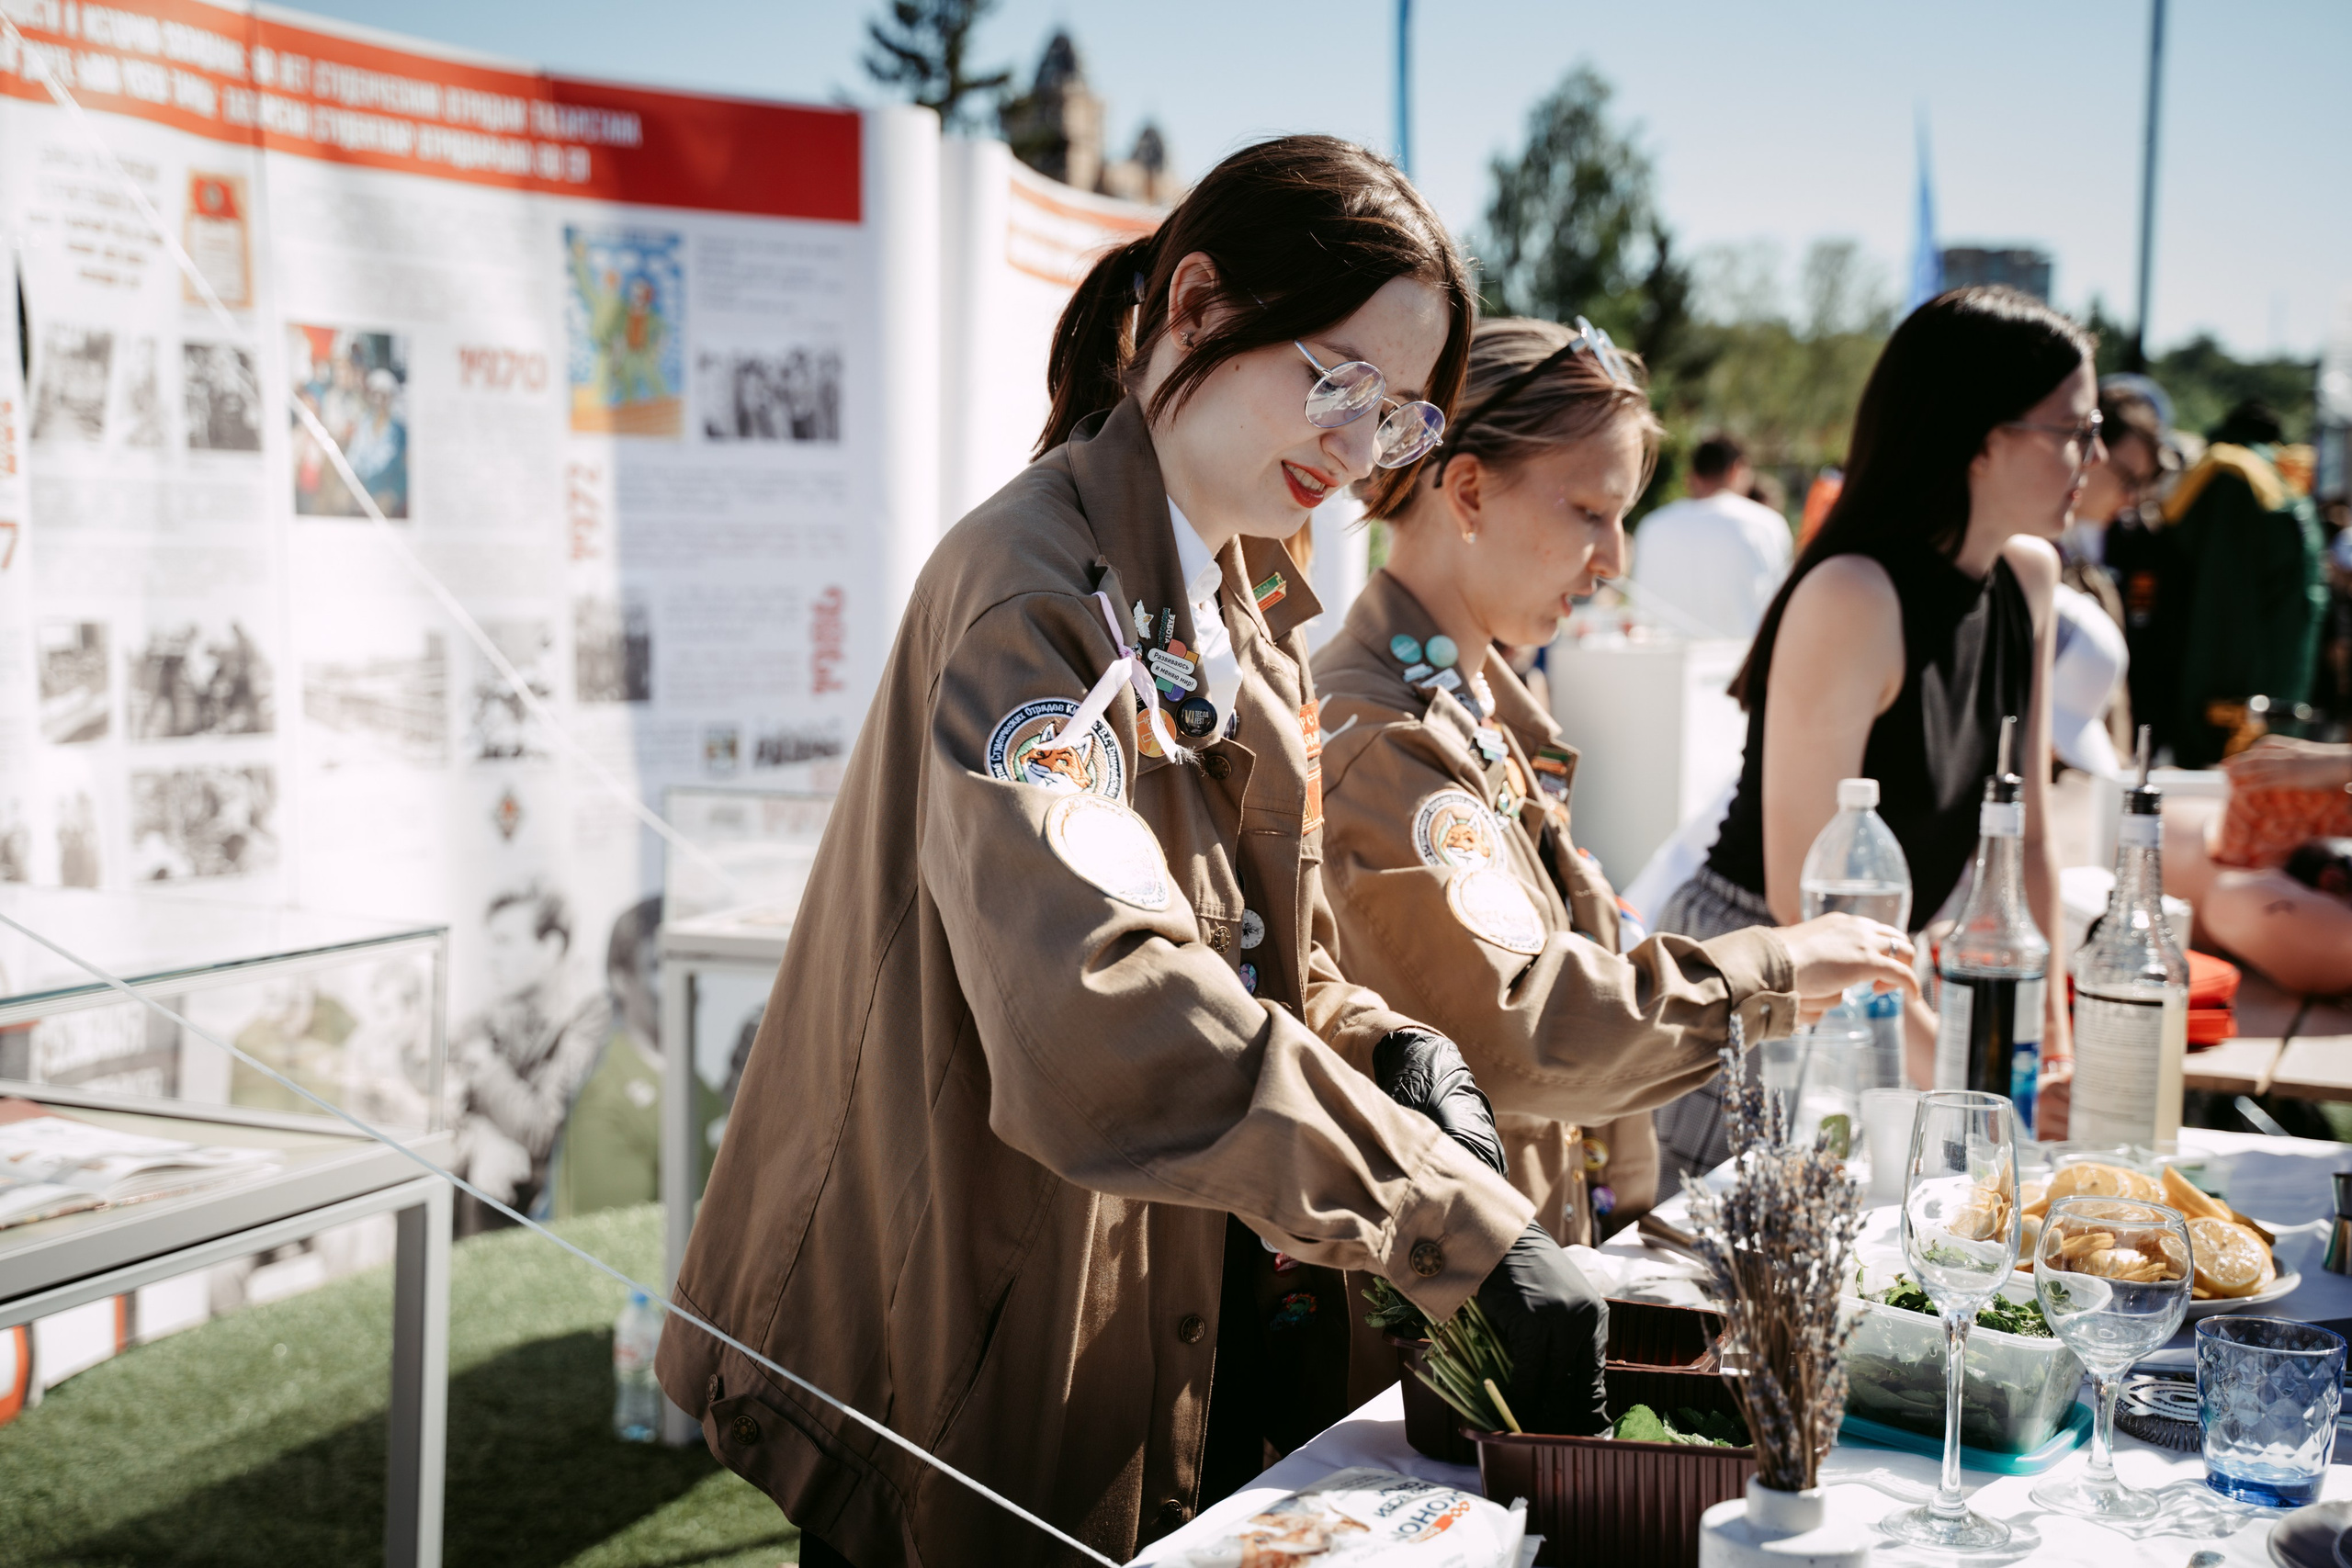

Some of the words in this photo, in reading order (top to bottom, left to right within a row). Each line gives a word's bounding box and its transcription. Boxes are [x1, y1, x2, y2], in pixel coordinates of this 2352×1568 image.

[1153, 651, 1190, 671] Развиваюсь
[1159, 667, 1180, 681] меняю
[1179, 677, 1194, 687] мир!
[1024, 704, 1065, 716] Отрядов
